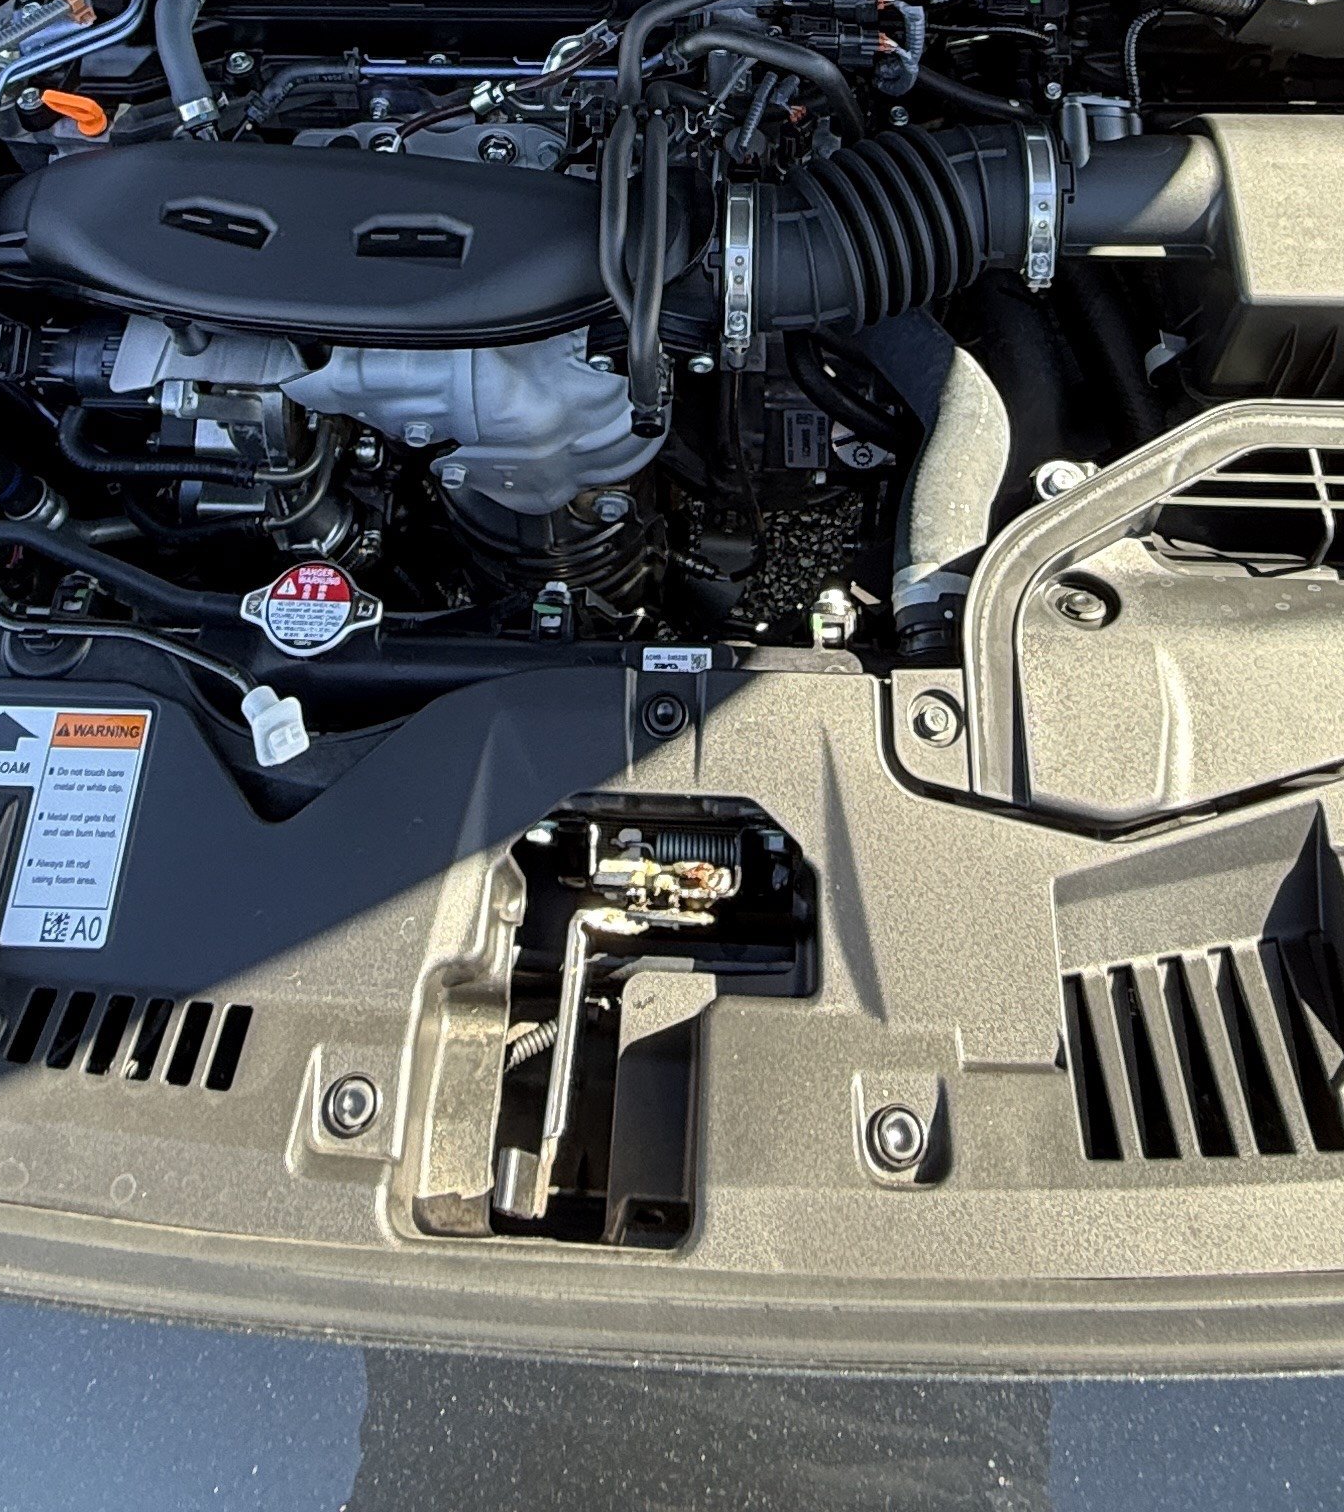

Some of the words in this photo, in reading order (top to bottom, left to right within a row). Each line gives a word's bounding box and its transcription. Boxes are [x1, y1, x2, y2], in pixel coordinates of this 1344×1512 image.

[73, 724, 141, 738] WARNING
[57, 767, 69, 776] Do
[70, 768, 83, 776] not
[84, 768, 105, 777] touch
[47, 812, 69, 821] Metal
[69, 813, 83, 821] rod
[102, 813, 116, 822] hot
[42, 828, 59, 836] and
[59, 829, 74, 837] can
[35, 859, 64, 870] Always
[76, 859, 91, 869] rod
[70, 915, 102, 942] A0
